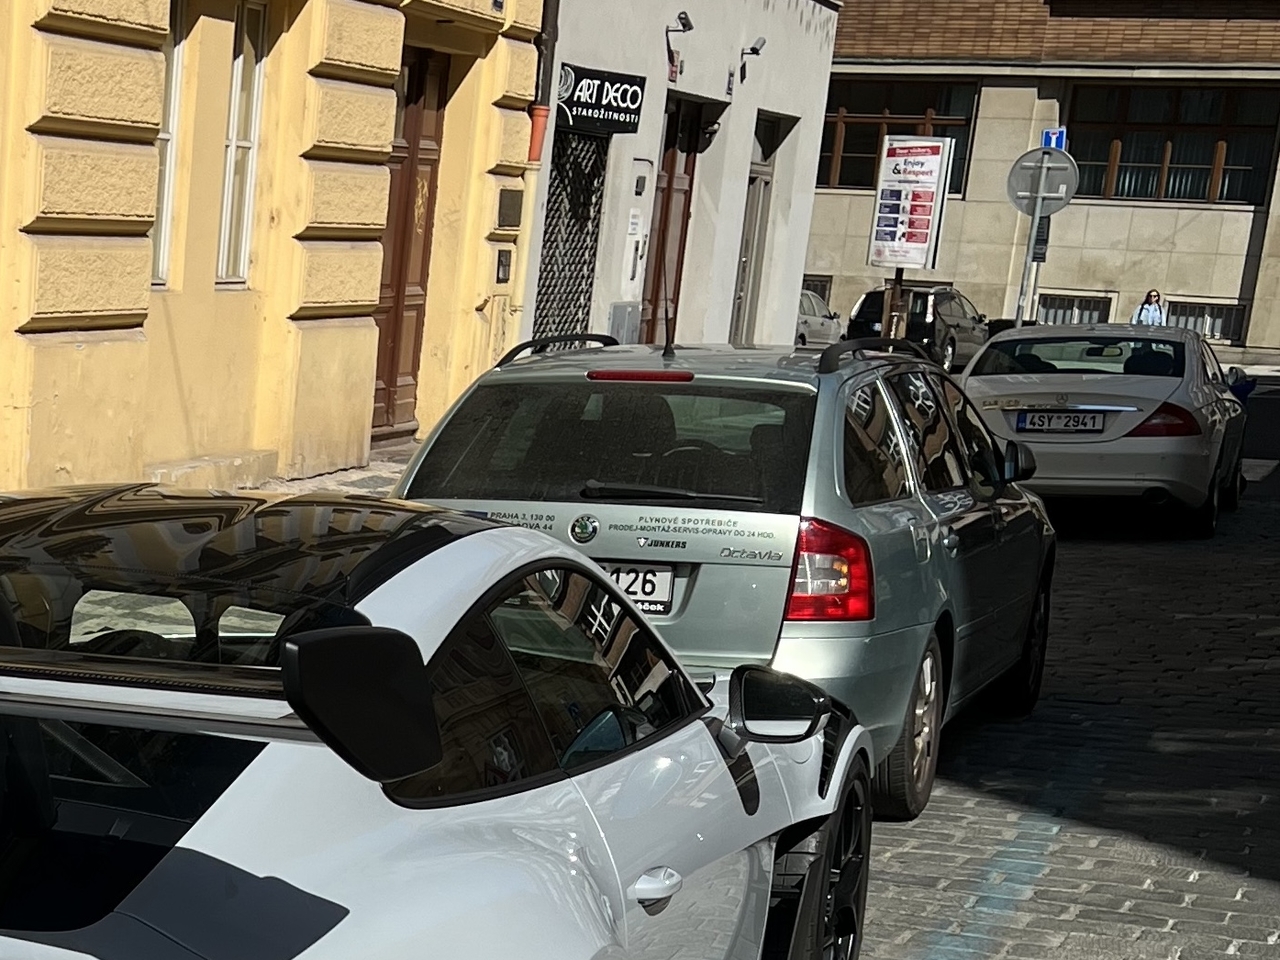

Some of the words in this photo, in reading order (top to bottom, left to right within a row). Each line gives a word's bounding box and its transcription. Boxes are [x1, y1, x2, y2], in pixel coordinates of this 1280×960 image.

[573, 78, 601, 104] ART
[601, 81, 642, 109] DECO
[572, 106, 638, 123] STAROŽITNOSTI
[892, 163, 901, 175] &
[902, 168, 933, 177] Respect
[903, 159, 926, 168] Enjoy
[1029, 415, 1055, 428] 4SY
[1063, 415, 1097, 428] 2941
[490, 512, 519, 520] PRAHA
[638, 515, 678, 524] PLYNOVÉ
[681, 517, 738, 527] SPOTŘEBIČE
[734, 529, 745, 537] DO
[648, 540, 687, 549] JUNKERS
[720, 546, 784, 561] Octavia
[600, 566, 657, 596] 126
